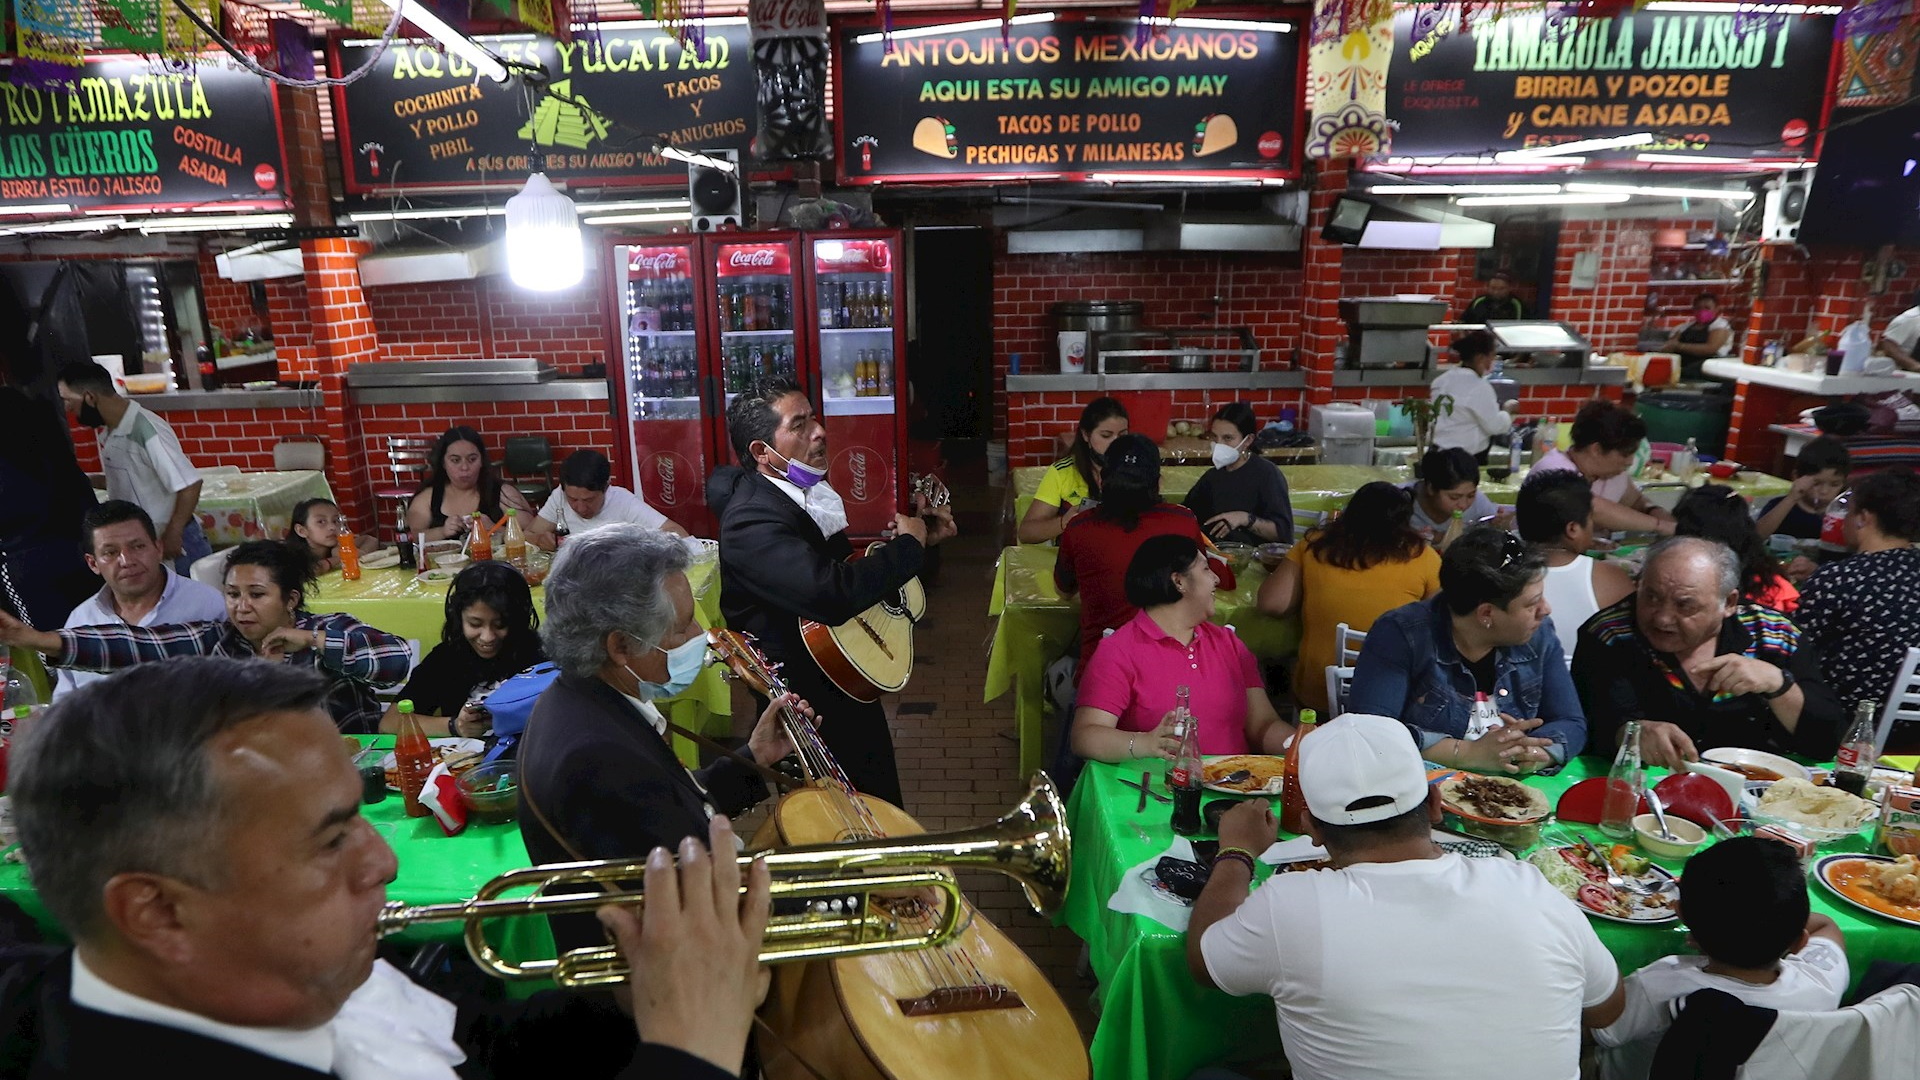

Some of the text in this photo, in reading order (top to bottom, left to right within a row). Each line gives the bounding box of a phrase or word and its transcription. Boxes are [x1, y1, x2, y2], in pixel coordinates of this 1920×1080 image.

[554, 36, 731, 74] YUCATAN
[881, 32, 1259, 68] ANTOJITOS MEXICANOS
[1472, 16, 1634, 71] TAMAZULA
[1640, 14, 1767, 70] JALISCO
[392, 45, 490, 80] AQU
[664, 74, 722, 99] TACOS
[919, 74, 1228, 102] AQUI ESTA SU AMIGO MAY
[1515, 74, 1731, 98] BIRRIA Y POZOLE
[0, 81, 42, 125] RO
[394, 83, 483, 118] COCHINITA
[690, 98, 704, 118] Y
[409, 109, 479, 140] Y POLLO
[998, 112, 1141, 134] TACOS DE POLLO
[1531, 104, 1630, 127] CARNE
[1633, 103, 1732, 126] ASADA
[49, 124, 158, 177] GÜEROS
[173, 125, 242, 166] COSTILLA
[429, 137, 474, 160] PIBIL
[852, 134, 880, 148] LOCAL
[966, 141, 1185, 165] PECHUGAS Y MILANESAS
[178, 155, 227, 188] ASADA
[465, 157, 475, 172] A
[478, 155, 504, 171] SUS
[569, 153, 588, 169] SU
[590, 152, 634, 169] AMIGO
[1, 174, 162, 199] BIRRIA ESTILO JALISCO
[730, 249, 777, 267] Coca-Cola
